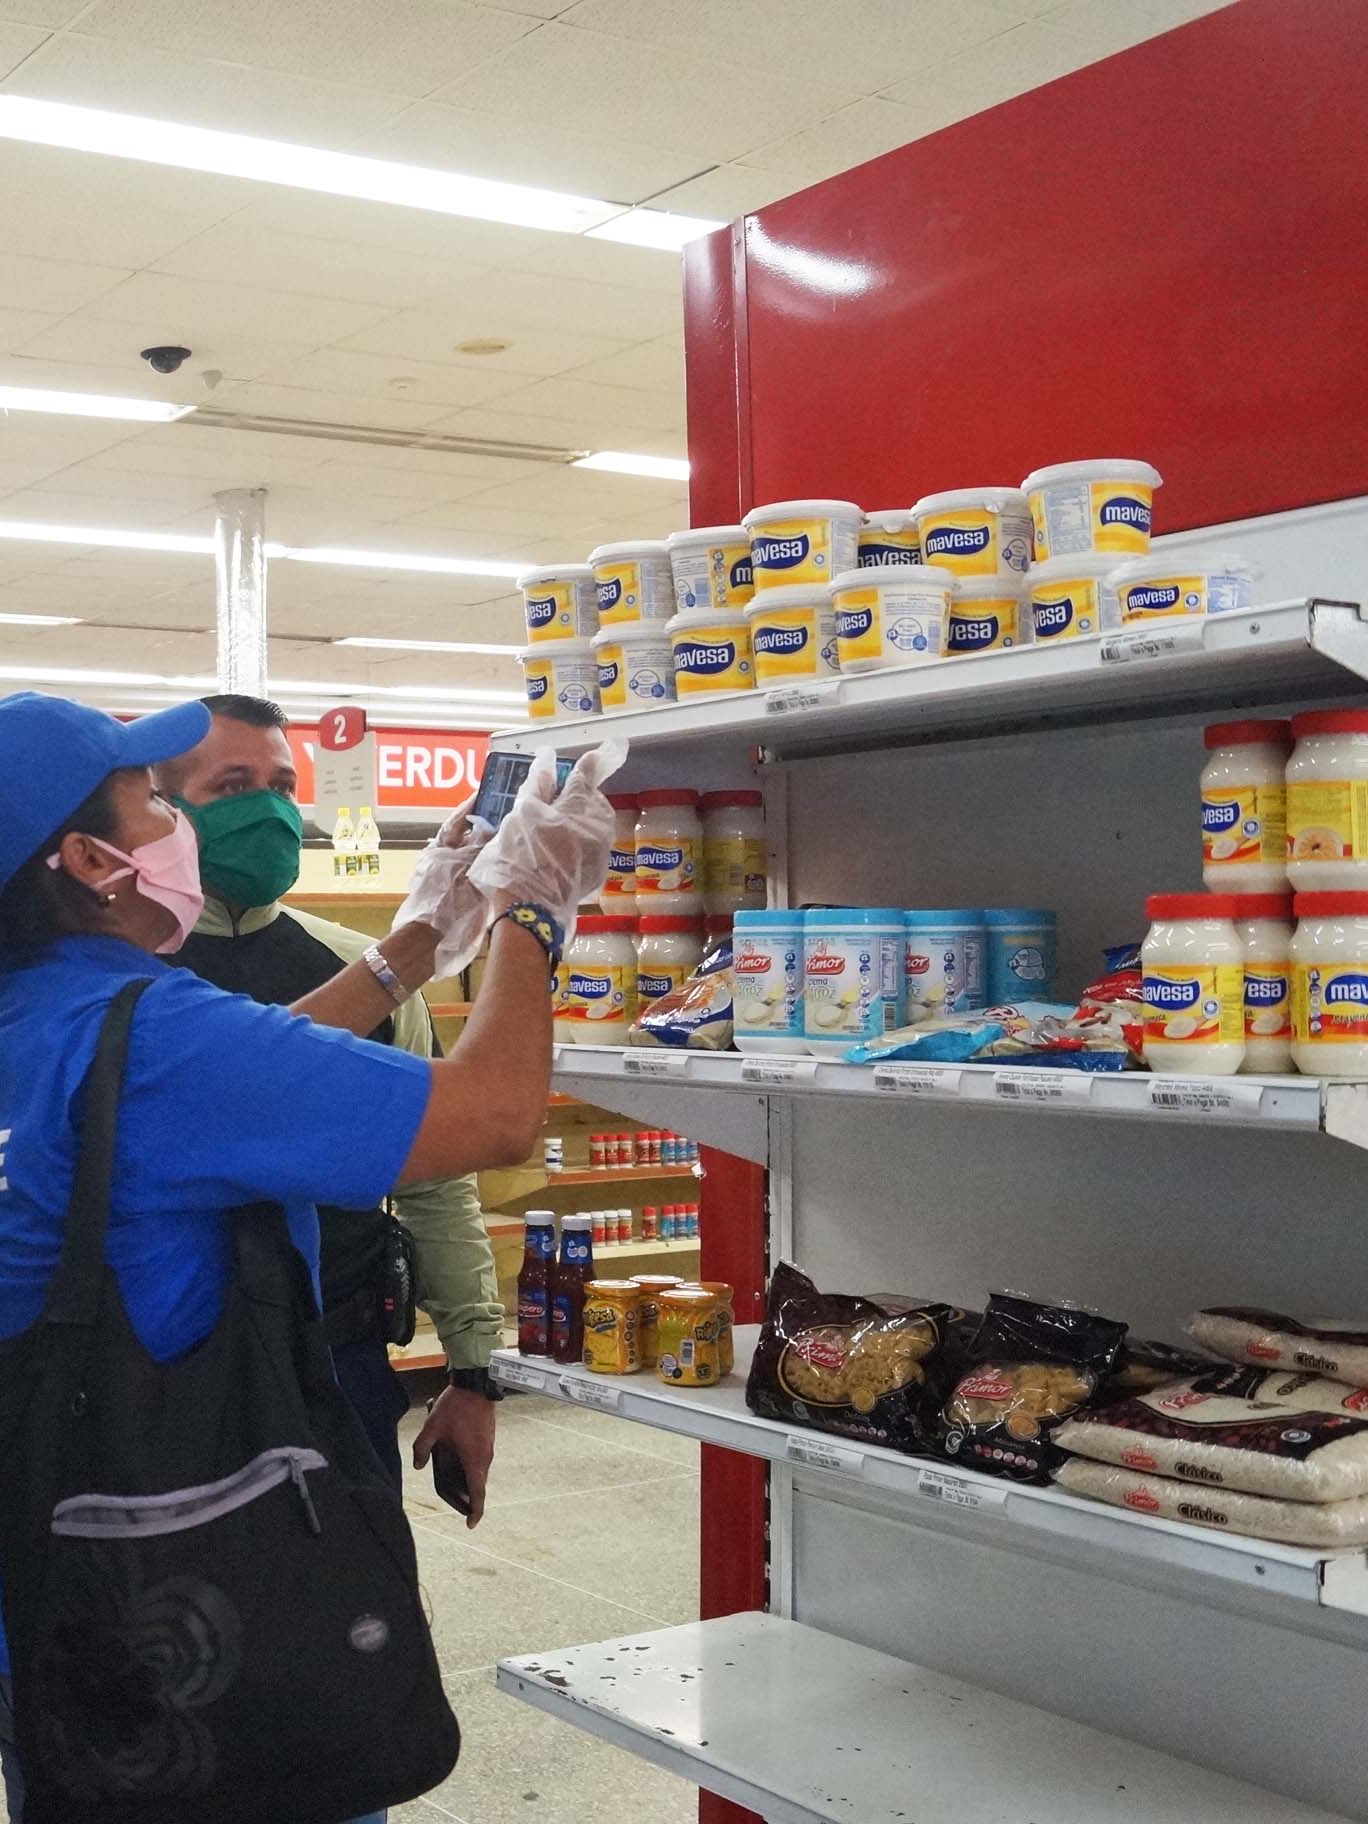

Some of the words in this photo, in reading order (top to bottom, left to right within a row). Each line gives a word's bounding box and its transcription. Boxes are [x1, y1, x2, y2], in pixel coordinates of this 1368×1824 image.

[1106, 506, 1151, 525] maves
[927, 532, 984, 553] mavesa
[596, 584, 617, 602] esa
[1129, 590, 1175, 608] mavesa
[529, 603, 551, 619] esa
[1034, 605, 1067, 628] vesa
[838, 614, 868, 633] vesa
[754, 631, 803, 651] mavesa
[333, 714, 347, 744] 2
[379, 745, 484, 788] ERDU
[1203, 807, 1234, 824] vesa
[1246, 983, 1281, 998] esa
[1331, 984, 1368, 1000] mav
